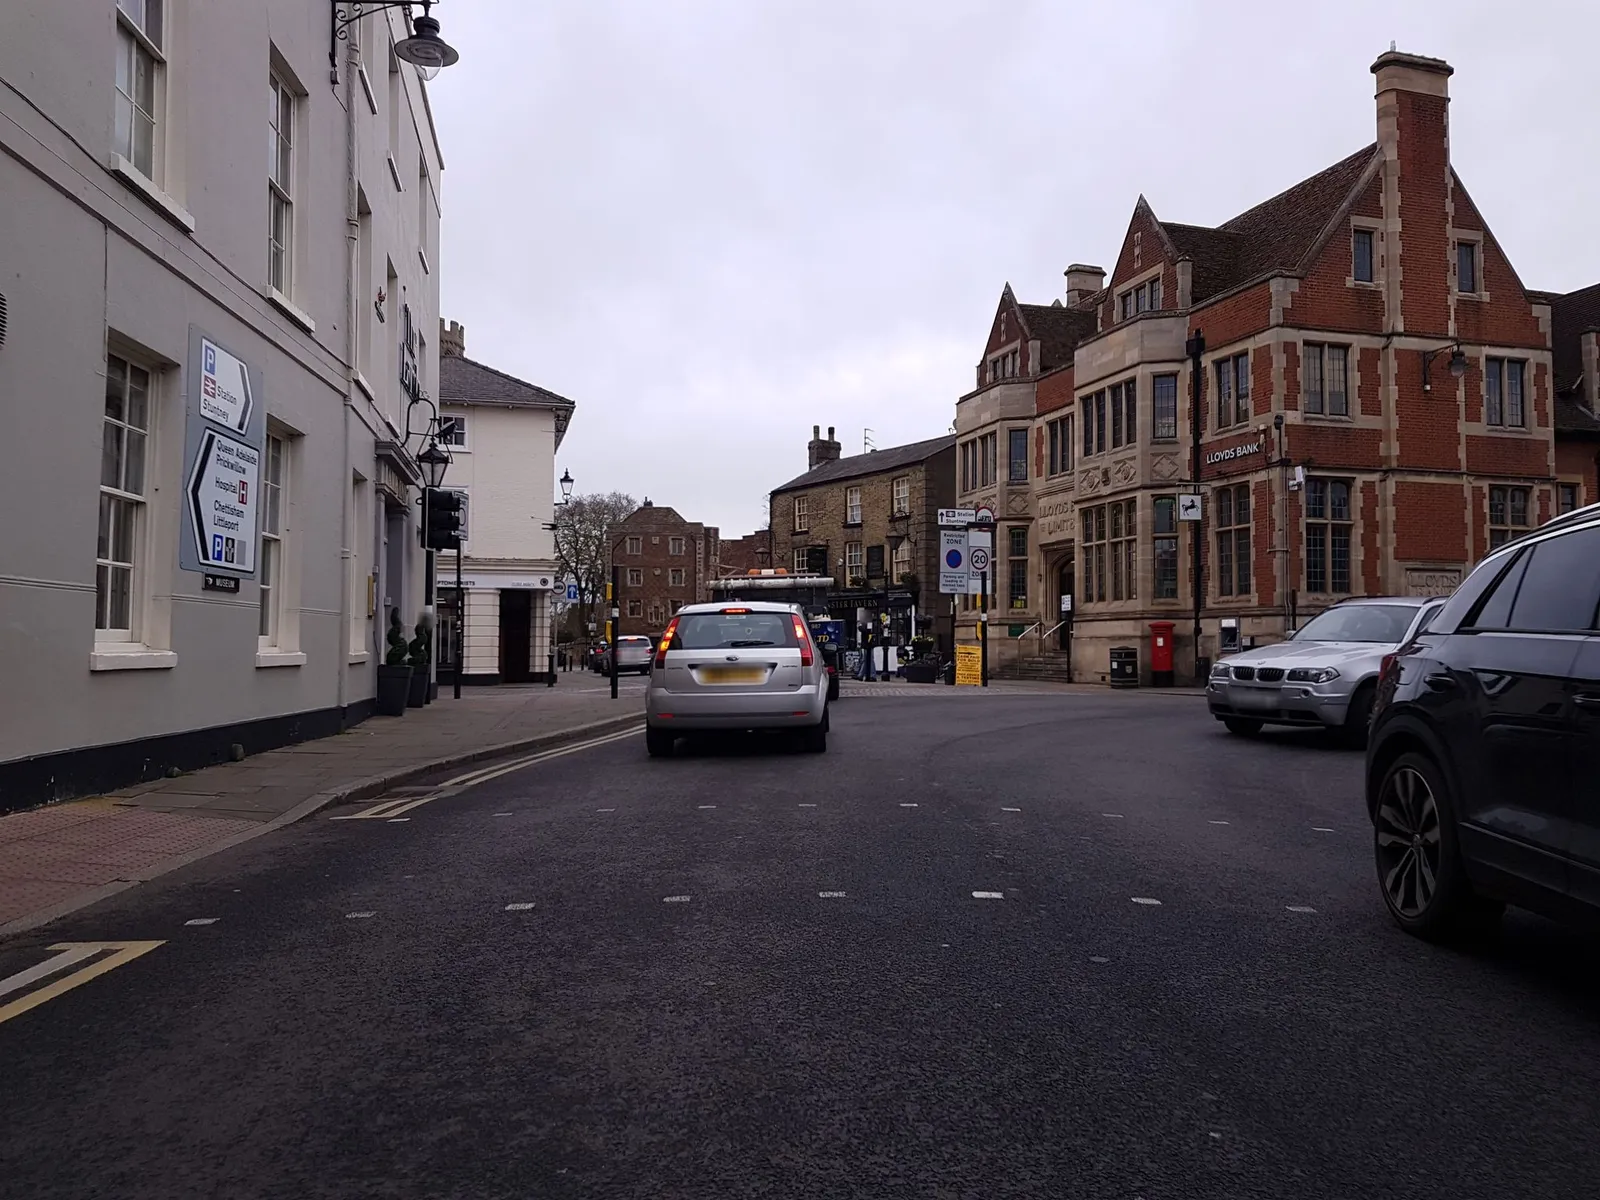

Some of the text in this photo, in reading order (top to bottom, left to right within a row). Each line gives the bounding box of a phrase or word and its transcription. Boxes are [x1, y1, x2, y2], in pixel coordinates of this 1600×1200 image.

[217, 385, 238, 406] Station
[203, 398, 229, 423] Stuntney
[216, 439, 258, 466] Queen Adelaide
[1207, 442, 1259, 464] LLOYDS BANK
[215, 454, 246, 475] Prickwillow
[215, 477, 238, 496] Hospital
[213, 500, 245, 519] Chettisham
[957, 510, 974, 518] Station
[213, 514, 239, 532] Littleport
[974, 554, 986, 565] 20
[215, 577, 235, 589] MUSEUM
[1408, 575, 1457, 588] LLOYDS
[850, 599, 878, 608] TAVERN
